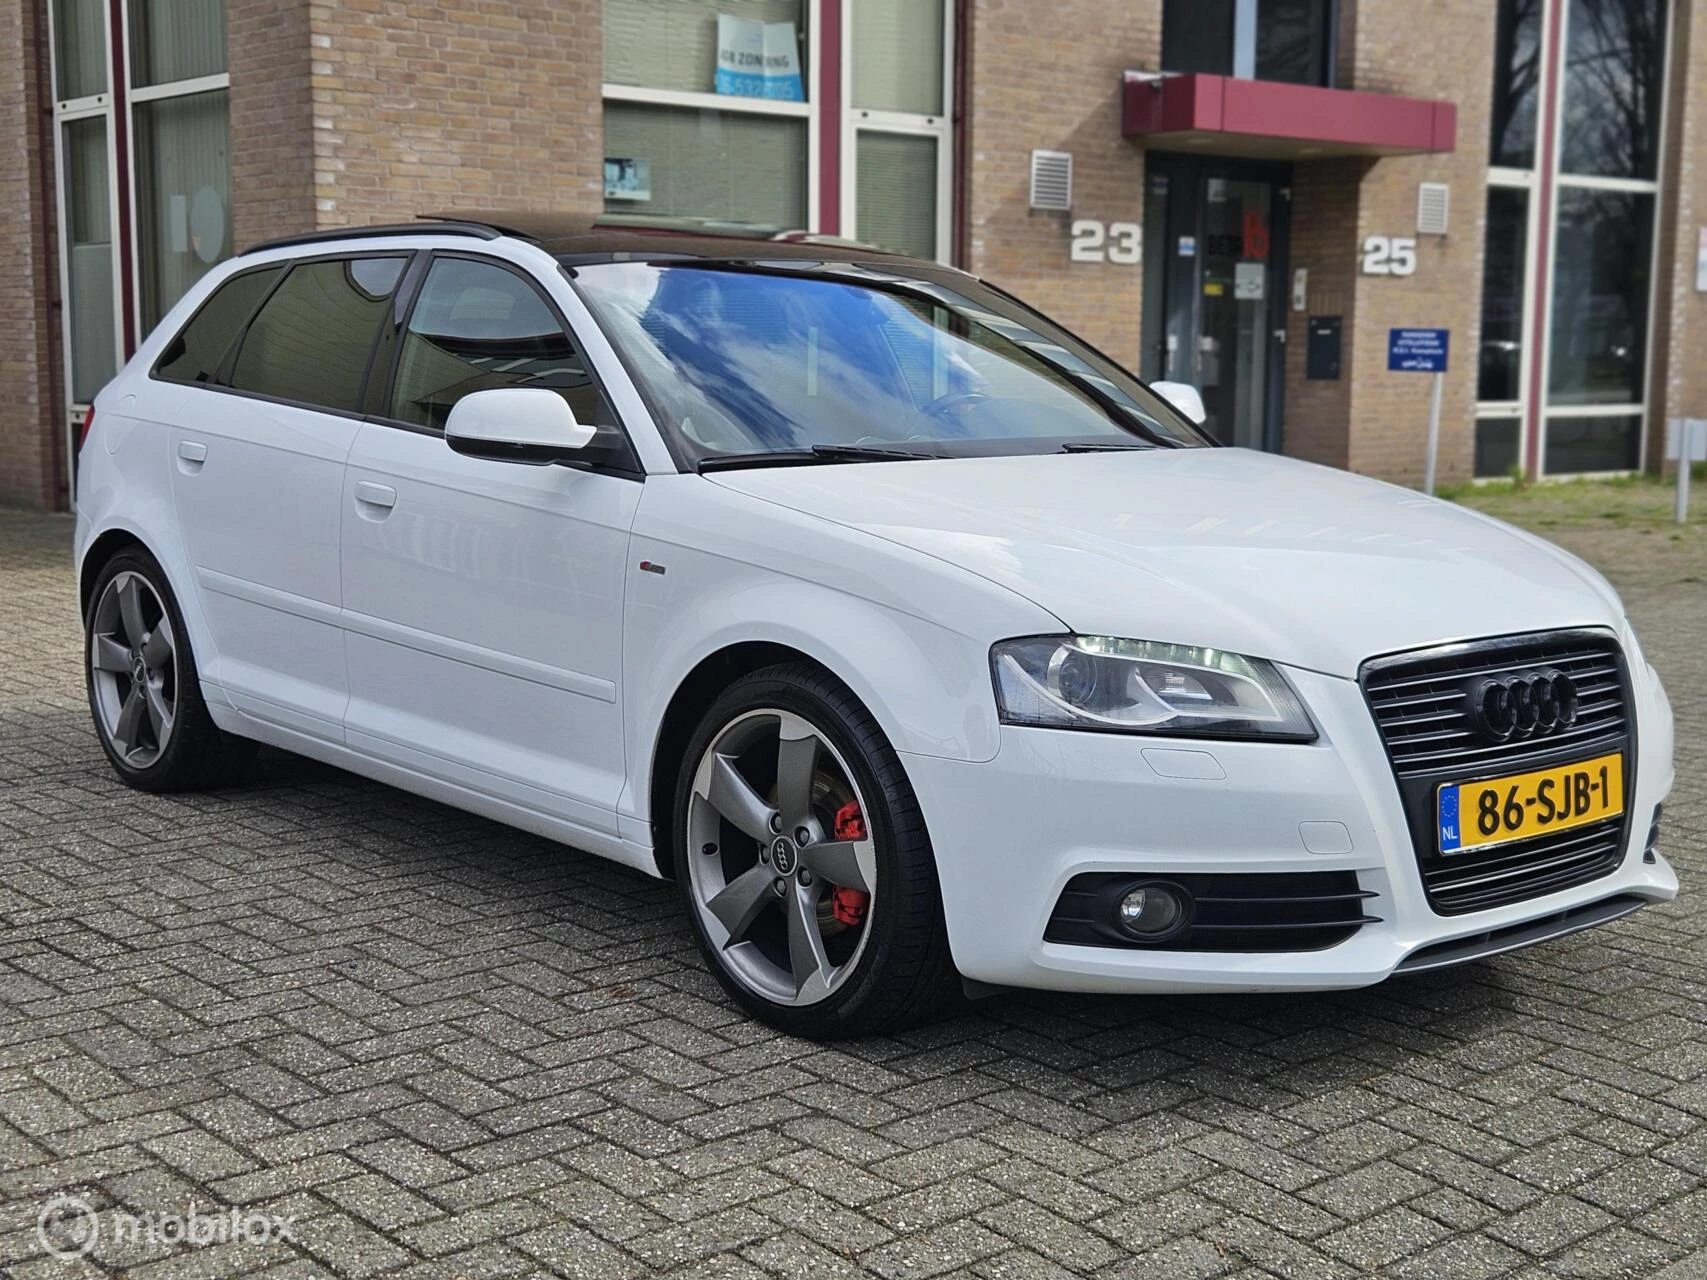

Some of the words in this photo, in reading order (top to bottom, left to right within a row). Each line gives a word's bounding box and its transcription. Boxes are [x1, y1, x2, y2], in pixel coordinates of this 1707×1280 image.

[1071, 220, 1143, 264] 23
[1363, 236, 1417, 275] 25
[1478, 765, 1609, 836] 86-SJB-1
[1442, 826, 1458, 841] NL
